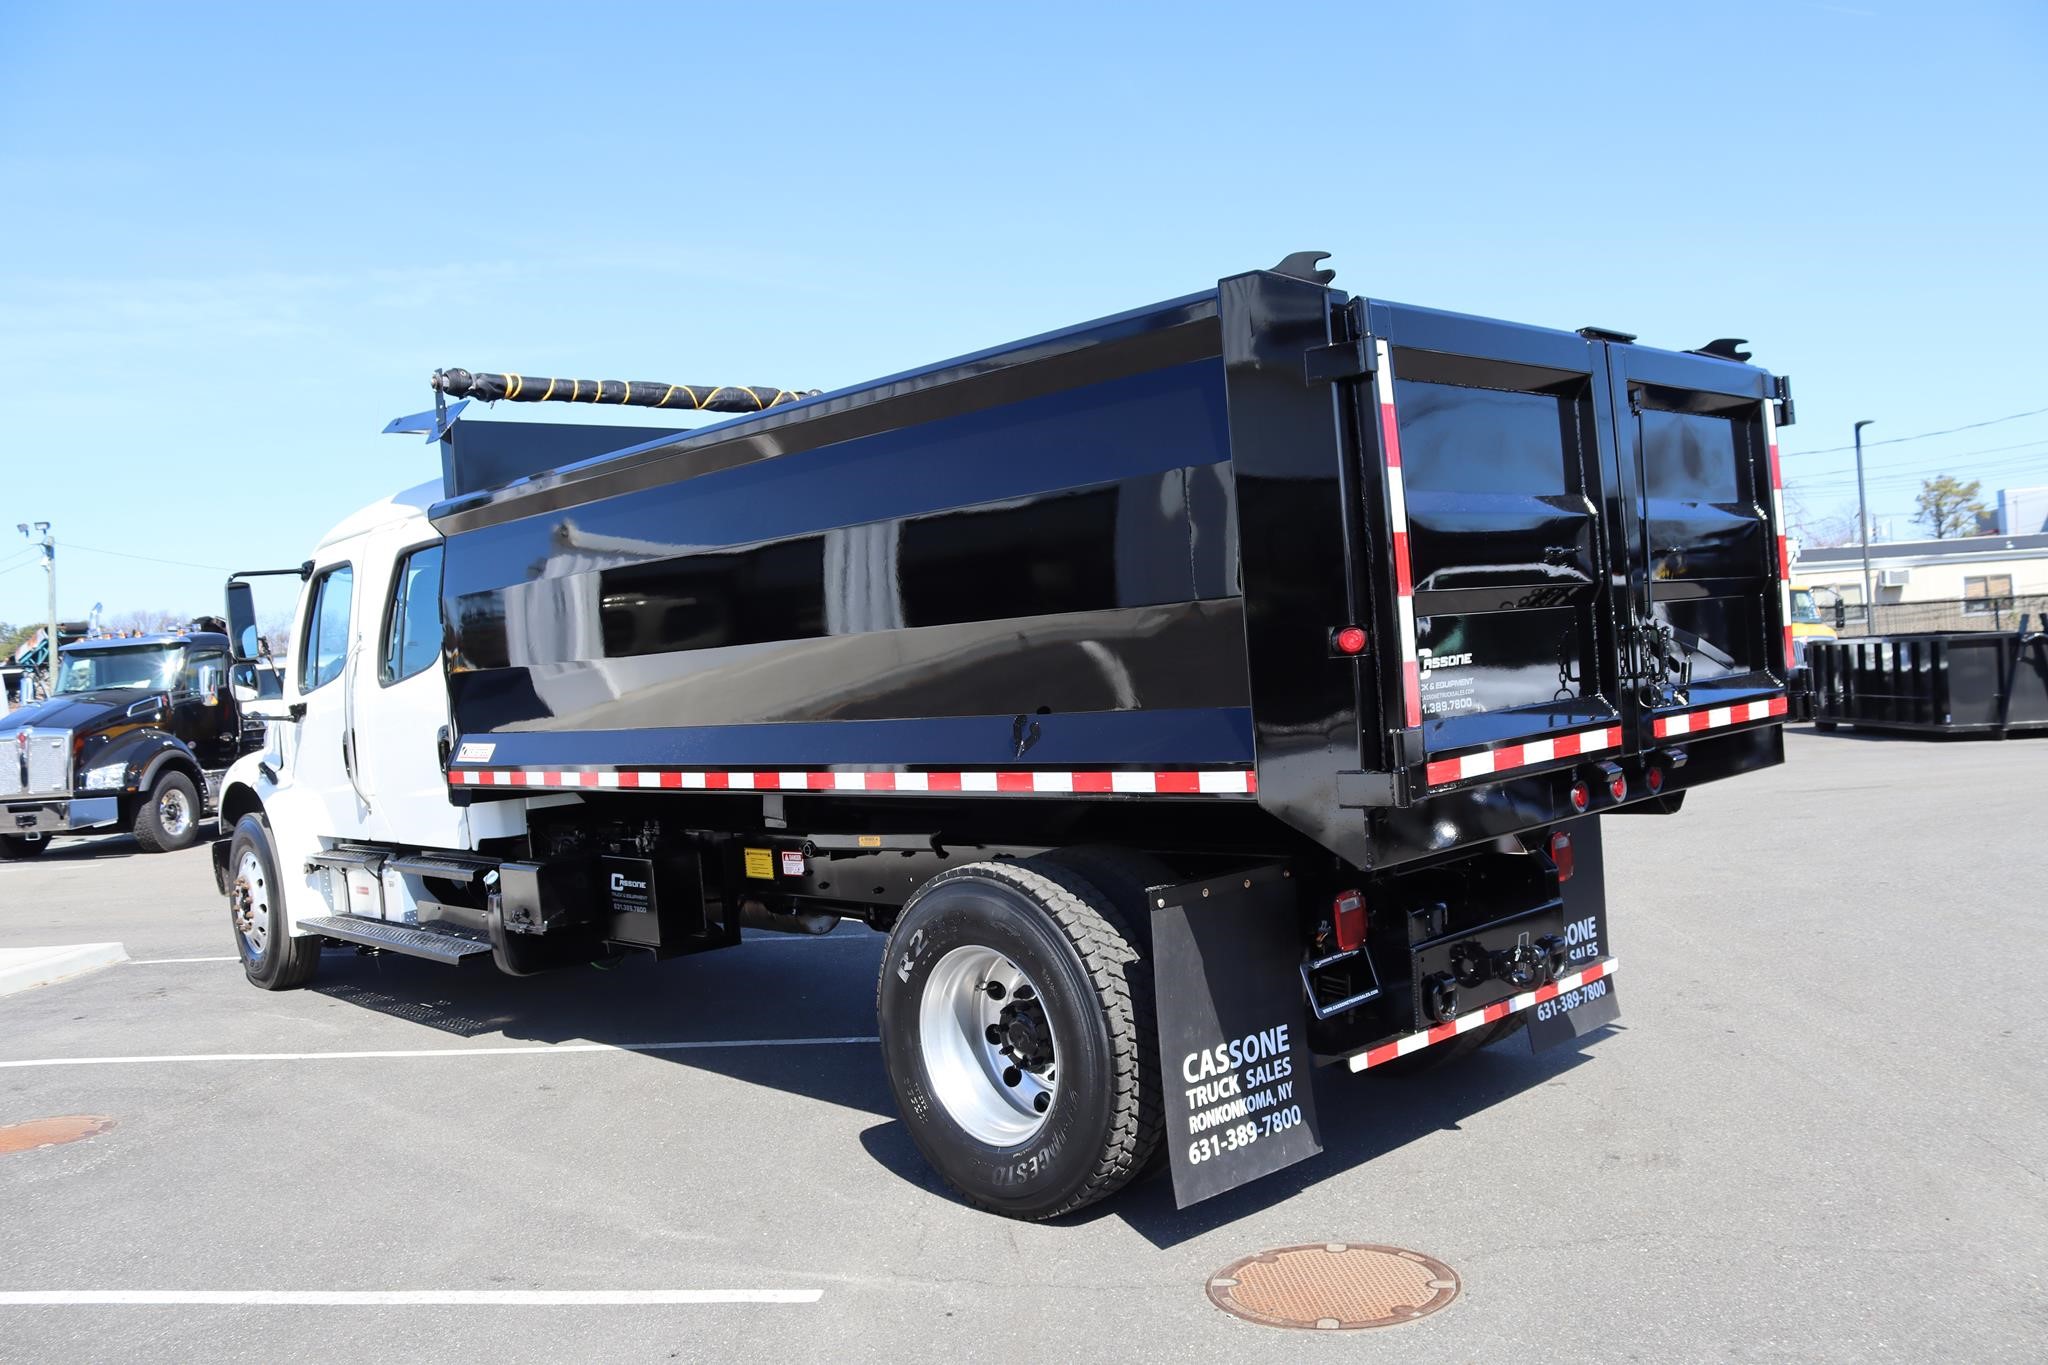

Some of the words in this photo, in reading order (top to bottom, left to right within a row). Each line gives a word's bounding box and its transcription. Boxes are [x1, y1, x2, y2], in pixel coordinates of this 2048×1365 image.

[1436, 677, 1474, 689] EQUIPMENT
[1537, 980, 1606, 1022] 631-389-7800
[1183, 1024, 1290, 1083] CASSONE
[1185, 1074, 1241, 1110] TRUCK
[1246, 1056, 1292, 1089] SALES
[1189, 1089, 1277, 1134] RONKONKOMA,
[1277, 1081, 1293, 1100] NY
[1188, 1104, 1301, 1165] 631-389-7800
